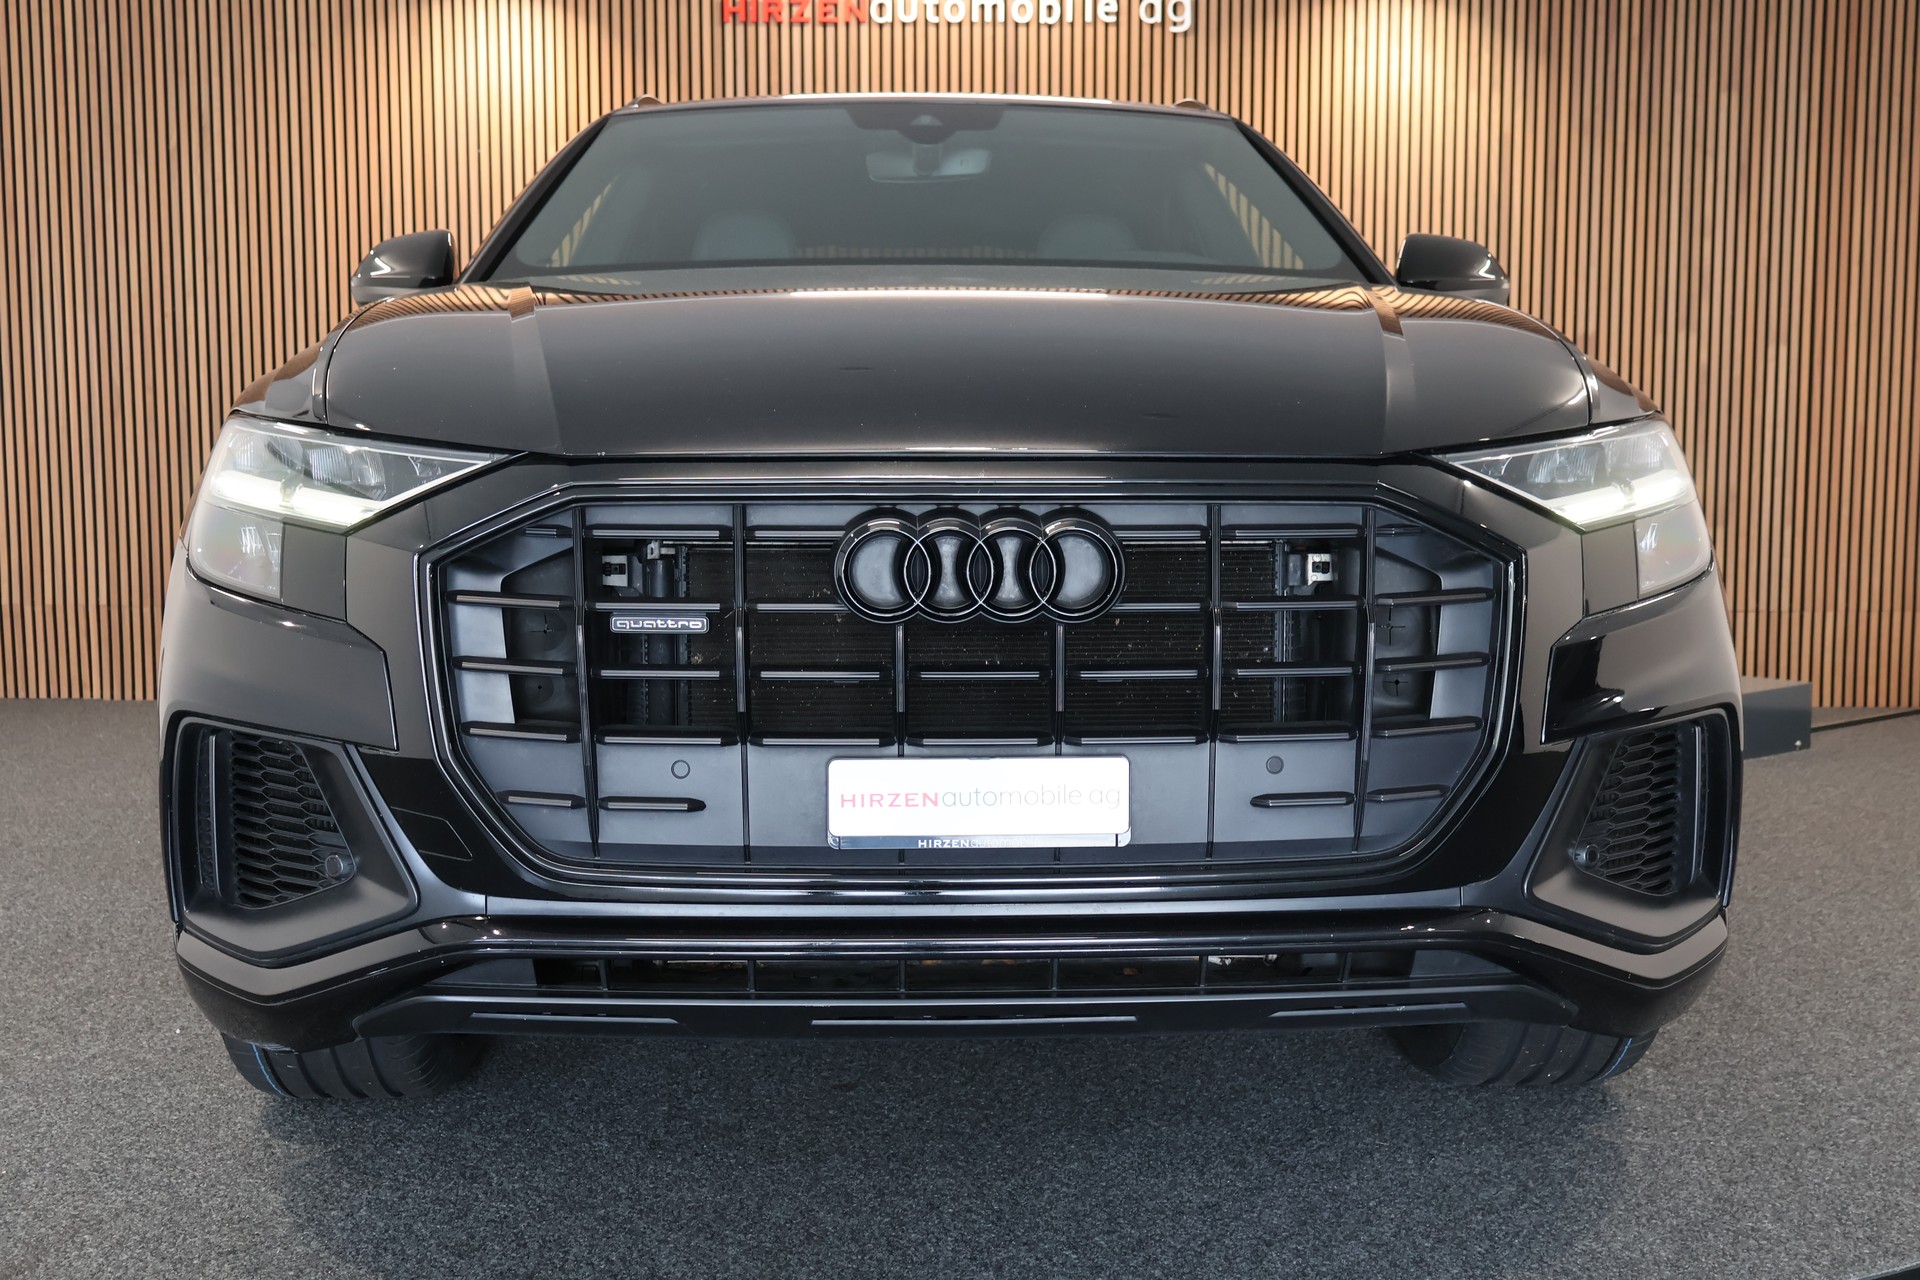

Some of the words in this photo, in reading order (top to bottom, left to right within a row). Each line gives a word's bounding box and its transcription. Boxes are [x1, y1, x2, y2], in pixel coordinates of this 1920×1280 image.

[1138, 0, 1192, 33] ag
[616, 619, 703, 630] quattro
[1088, 787, 1121, 810] ag
